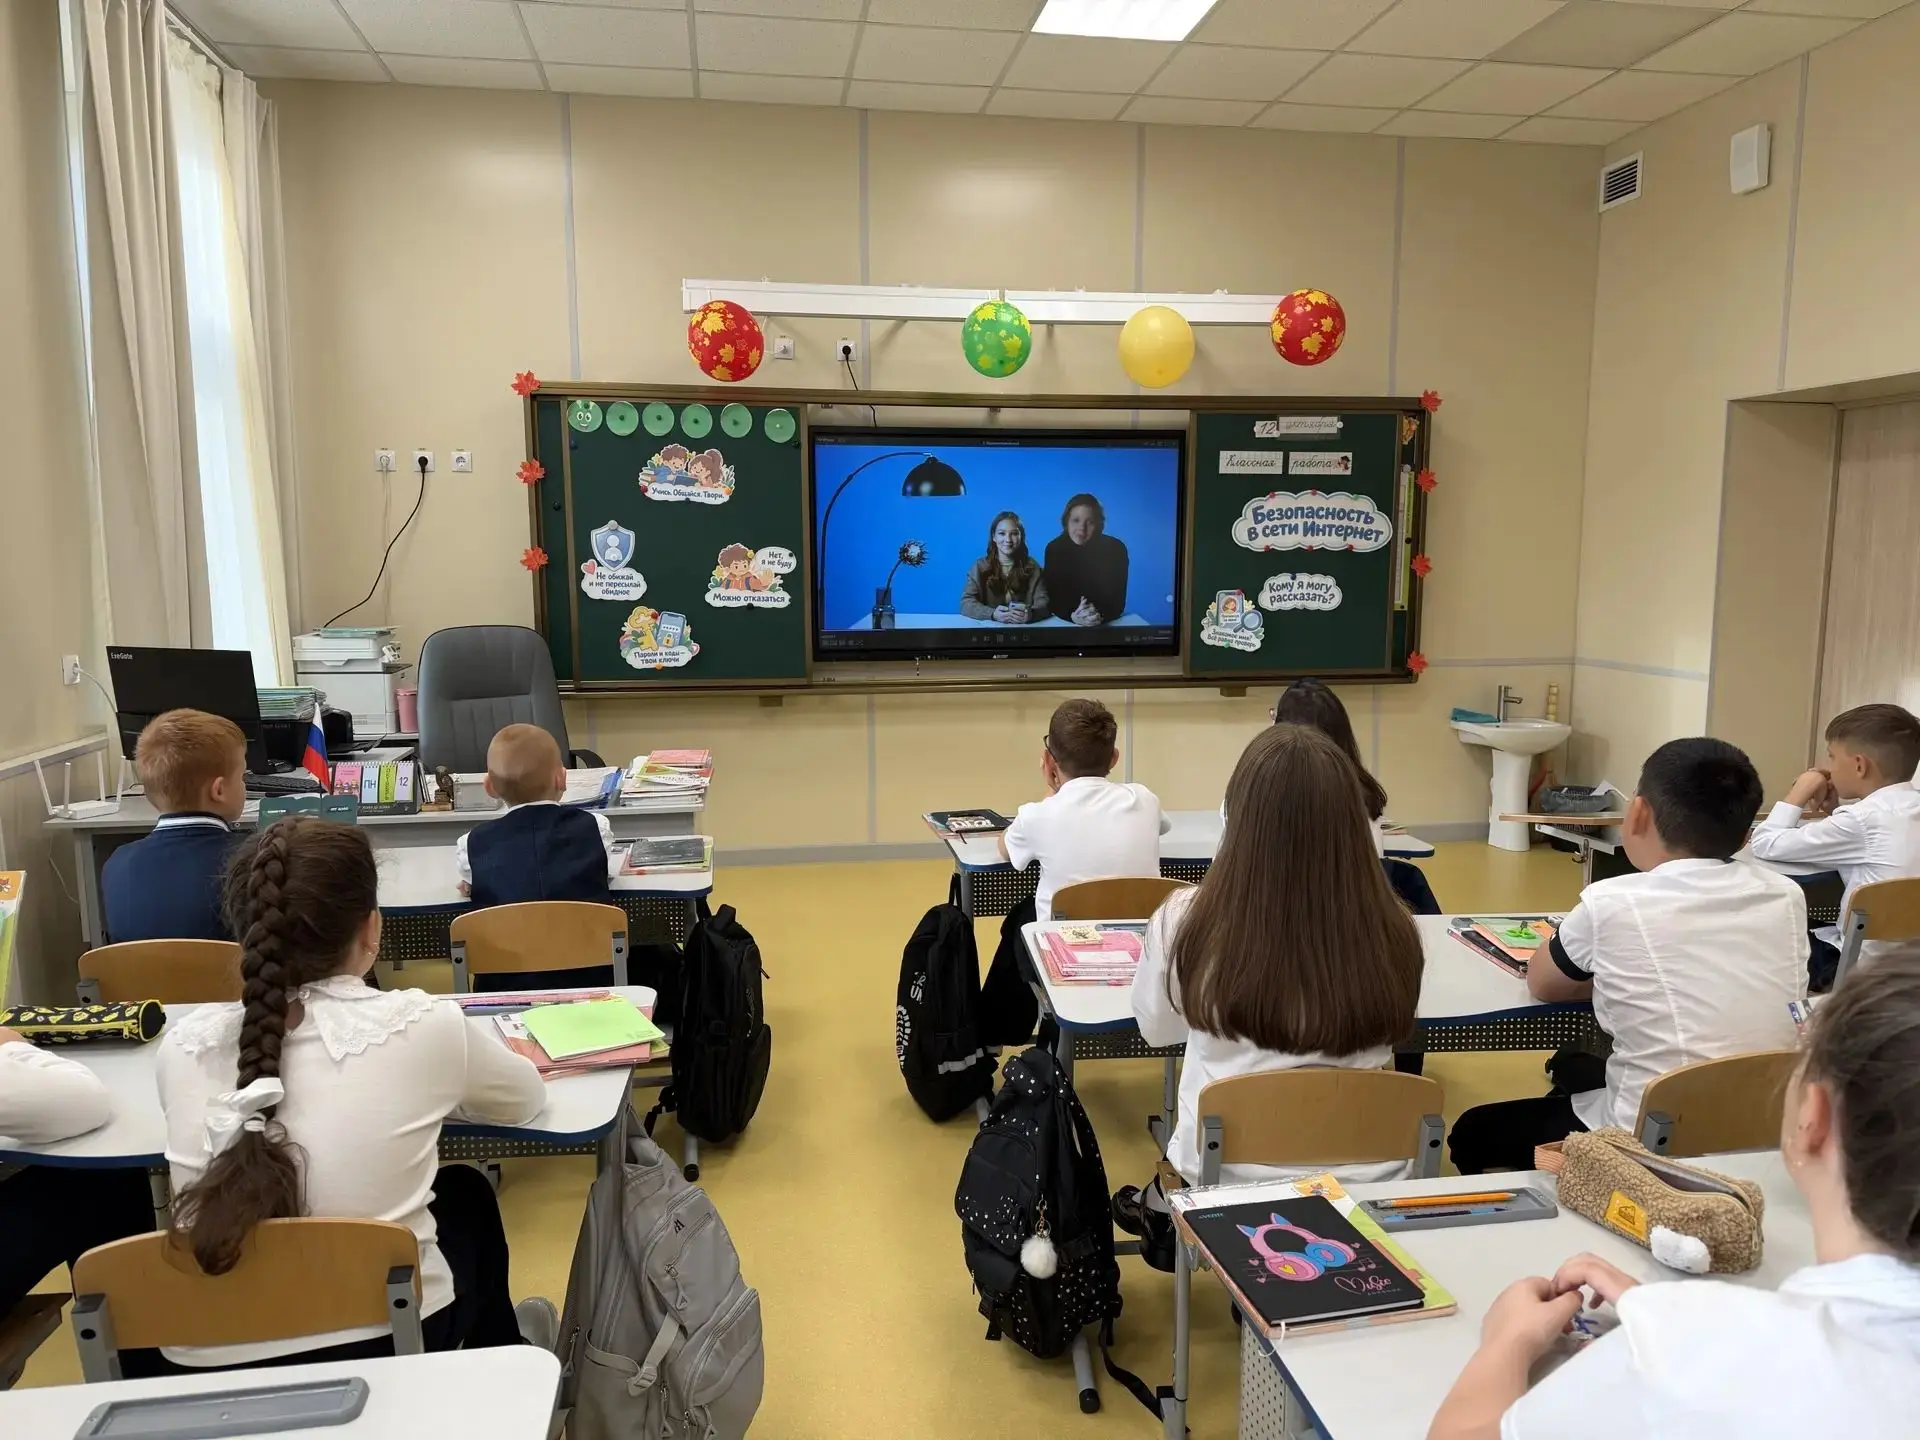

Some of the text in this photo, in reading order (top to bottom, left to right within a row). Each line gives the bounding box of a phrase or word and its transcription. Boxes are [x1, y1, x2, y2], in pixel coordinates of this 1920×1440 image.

[1260, 421, 1276, 435] 12
[1226, 454, 1332, 473] Классная работа
[703, 490, 725, 500] Твори.
[1252, 505, 1375, 525] Безопасность
[1247, 521, 1384, 542] в сети Интернет
[768, 551, 784, 560] Нет,
[777, 559, 792, 569] буду
[601, 588, 630, 596] обидное
[1269, 581, 1294, 593] Кому
[1306, 582, 1332, 594] могу
[713, 593, 741, 601] Можно
[1270, 593, 1335, 606] рассказать?
[364, 780, 376, 789] ПН
[400, 777, 409, 787] 12
[1334, 1275, 1391, 1295] Music
